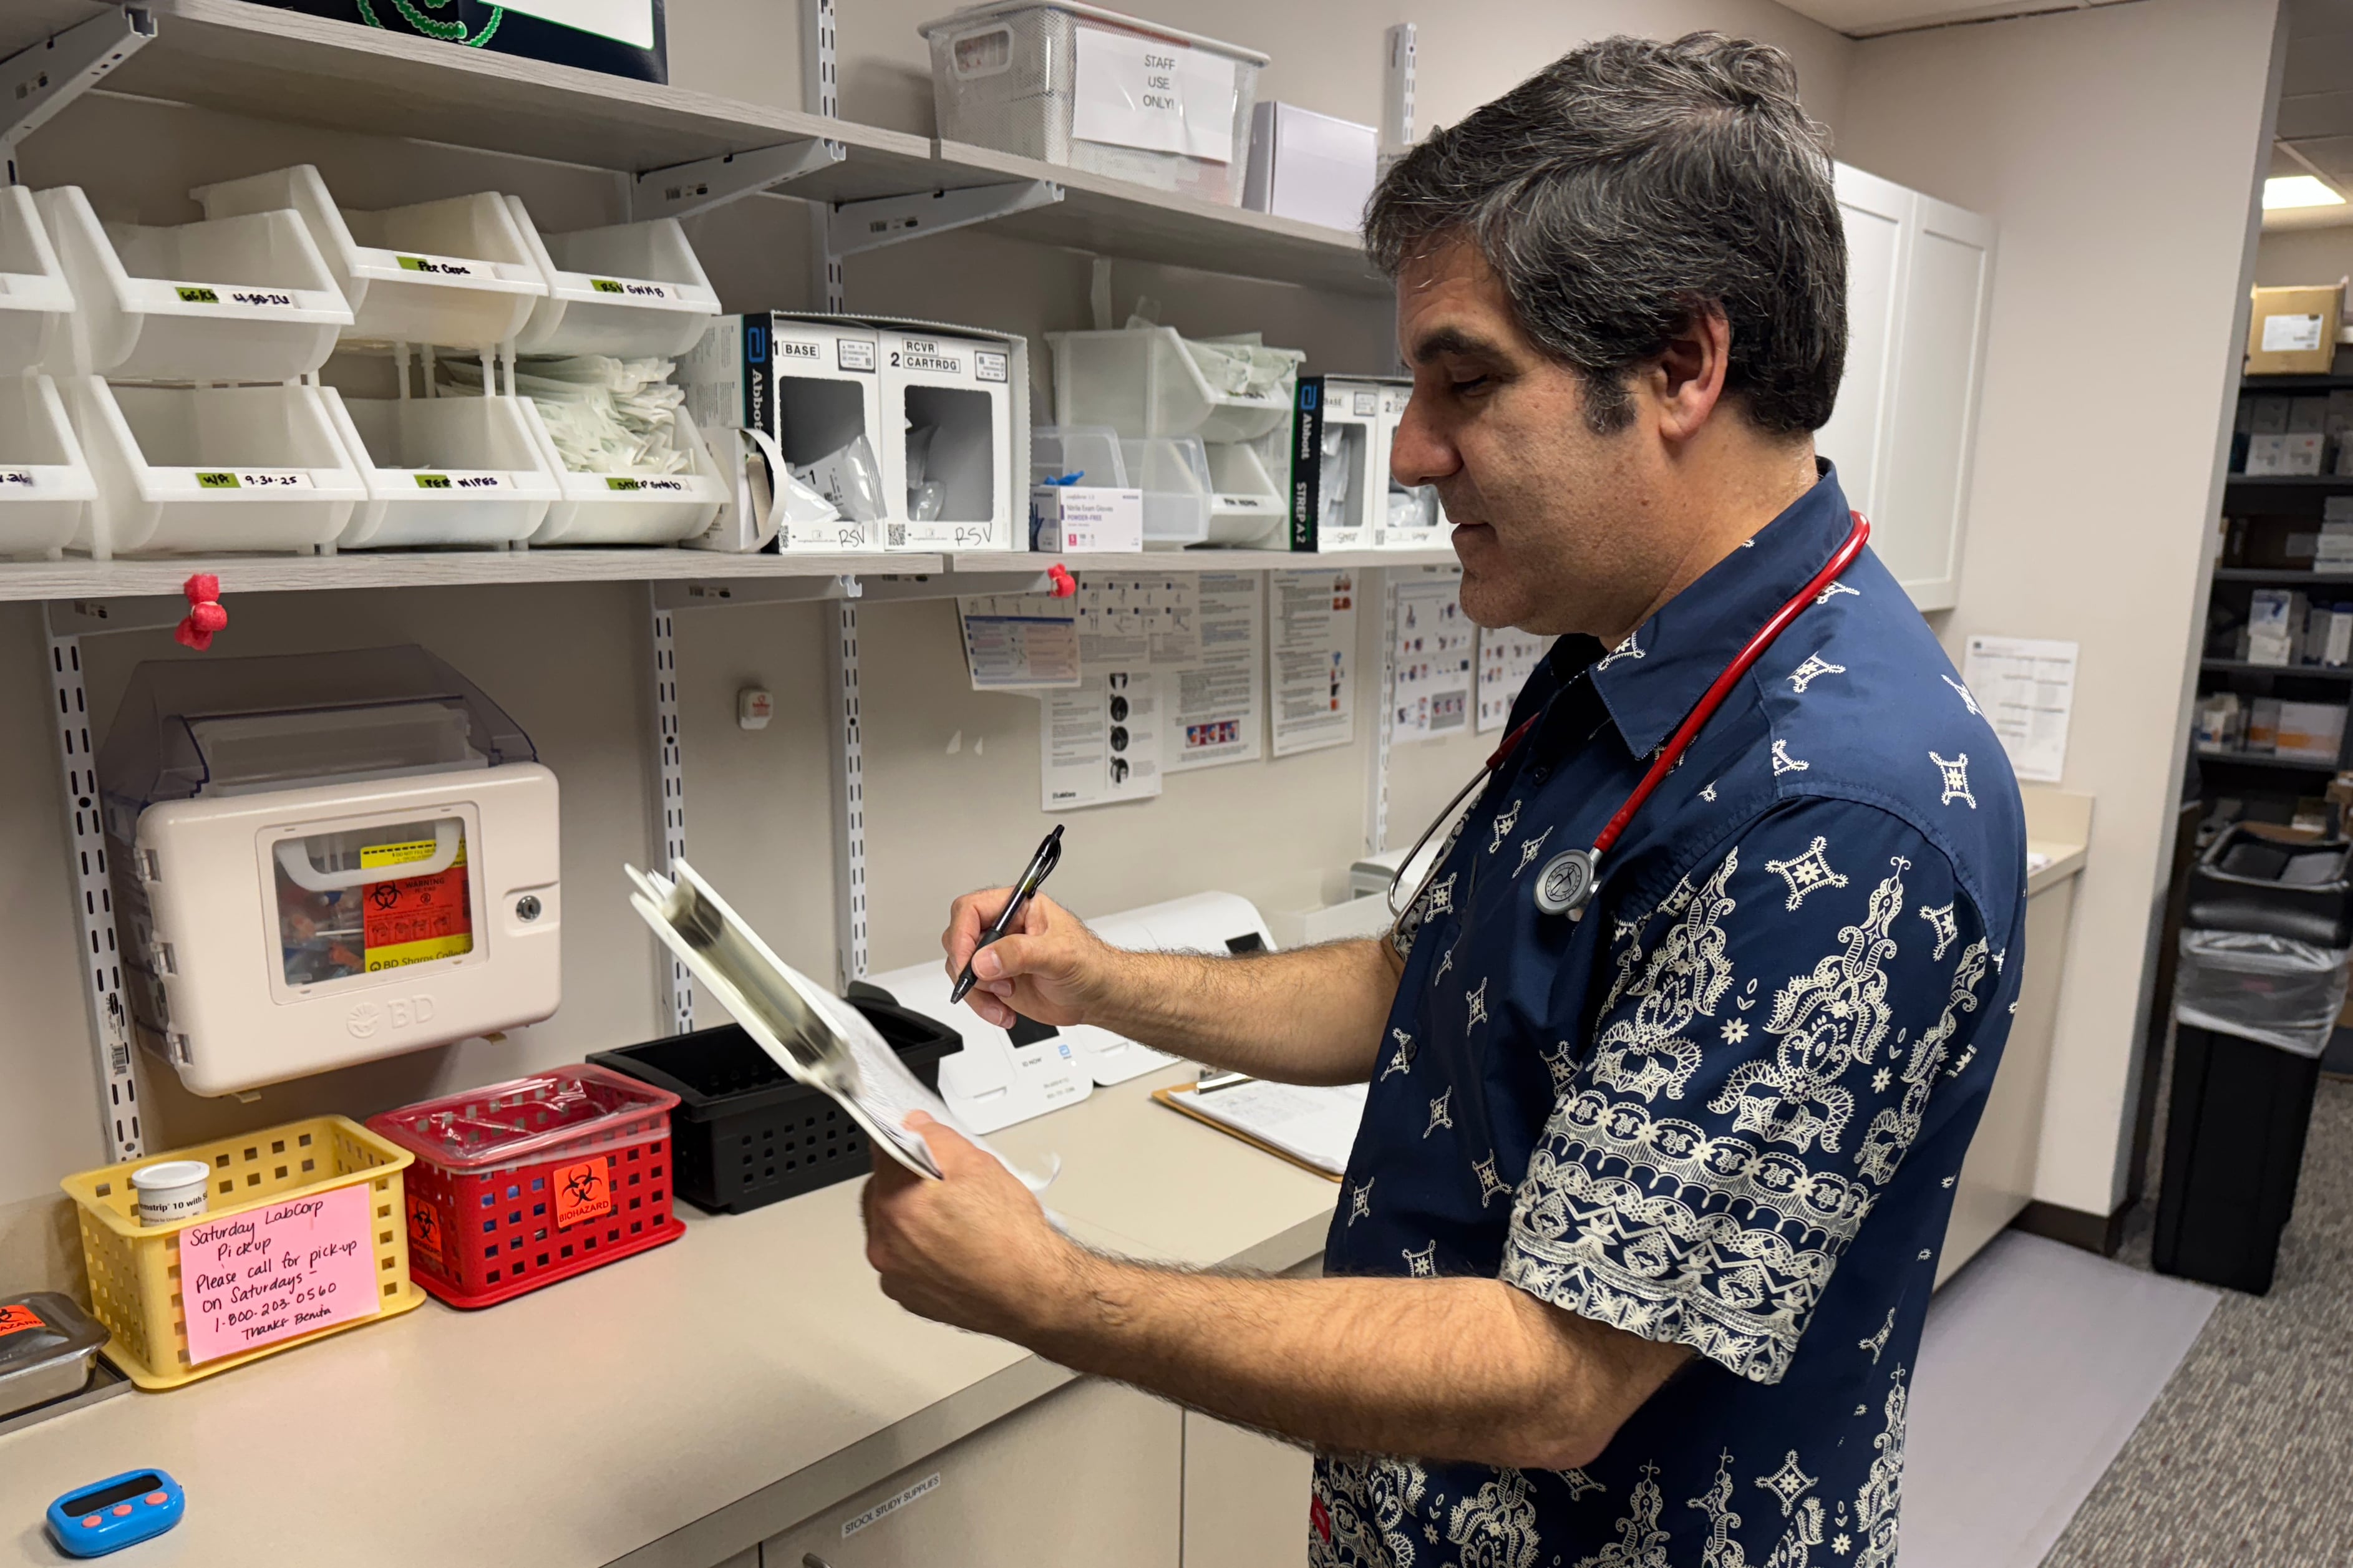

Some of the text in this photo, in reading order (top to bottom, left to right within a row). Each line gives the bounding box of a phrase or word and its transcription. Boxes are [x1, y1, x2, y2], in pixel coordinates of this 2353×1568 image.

[1144, 54, 1176, 70] STAFF
[1148, 75, 1170, 90] USE
[1143, 94, 1175, 110] ONLY!
[600, 283, 664, 298] RSV SWAB
[774, 340, 817, 356] 1 BASE
[906, 341, 935, 353] RCVR
[891, 352, 957, 370] 2 CARTRDG
[752, 368, 764, 430] Abbot
[1301, 412, 1312, 460] Abbott
[457, 477, 498, 488] WIPES
[1296, 482, 1307, 544] STREP A 2
[838, 525, 865, 547] RSV
[954, 523, 992, 546] RSV
[406, 878, 445, 889] WARNING
[383, 959, 399, 969] BD
[387, 994, 436, 1030] BD
[173, 1201, 185, 1210] 10
[186, 1196, 202, 1207] with
[559, 1201, 609, 1222] BIOHAZARD
[190, 1200, 324, 1246] Saturday LabCorp
[196, 1239, 357, 1294] Please call for pick-up
[202, 1297, 222, 1314] on
[230, 1272, 303, 1304] Saturdays
[845, 1476, 939, 1534] STOOL STUDY SUPPLIES
